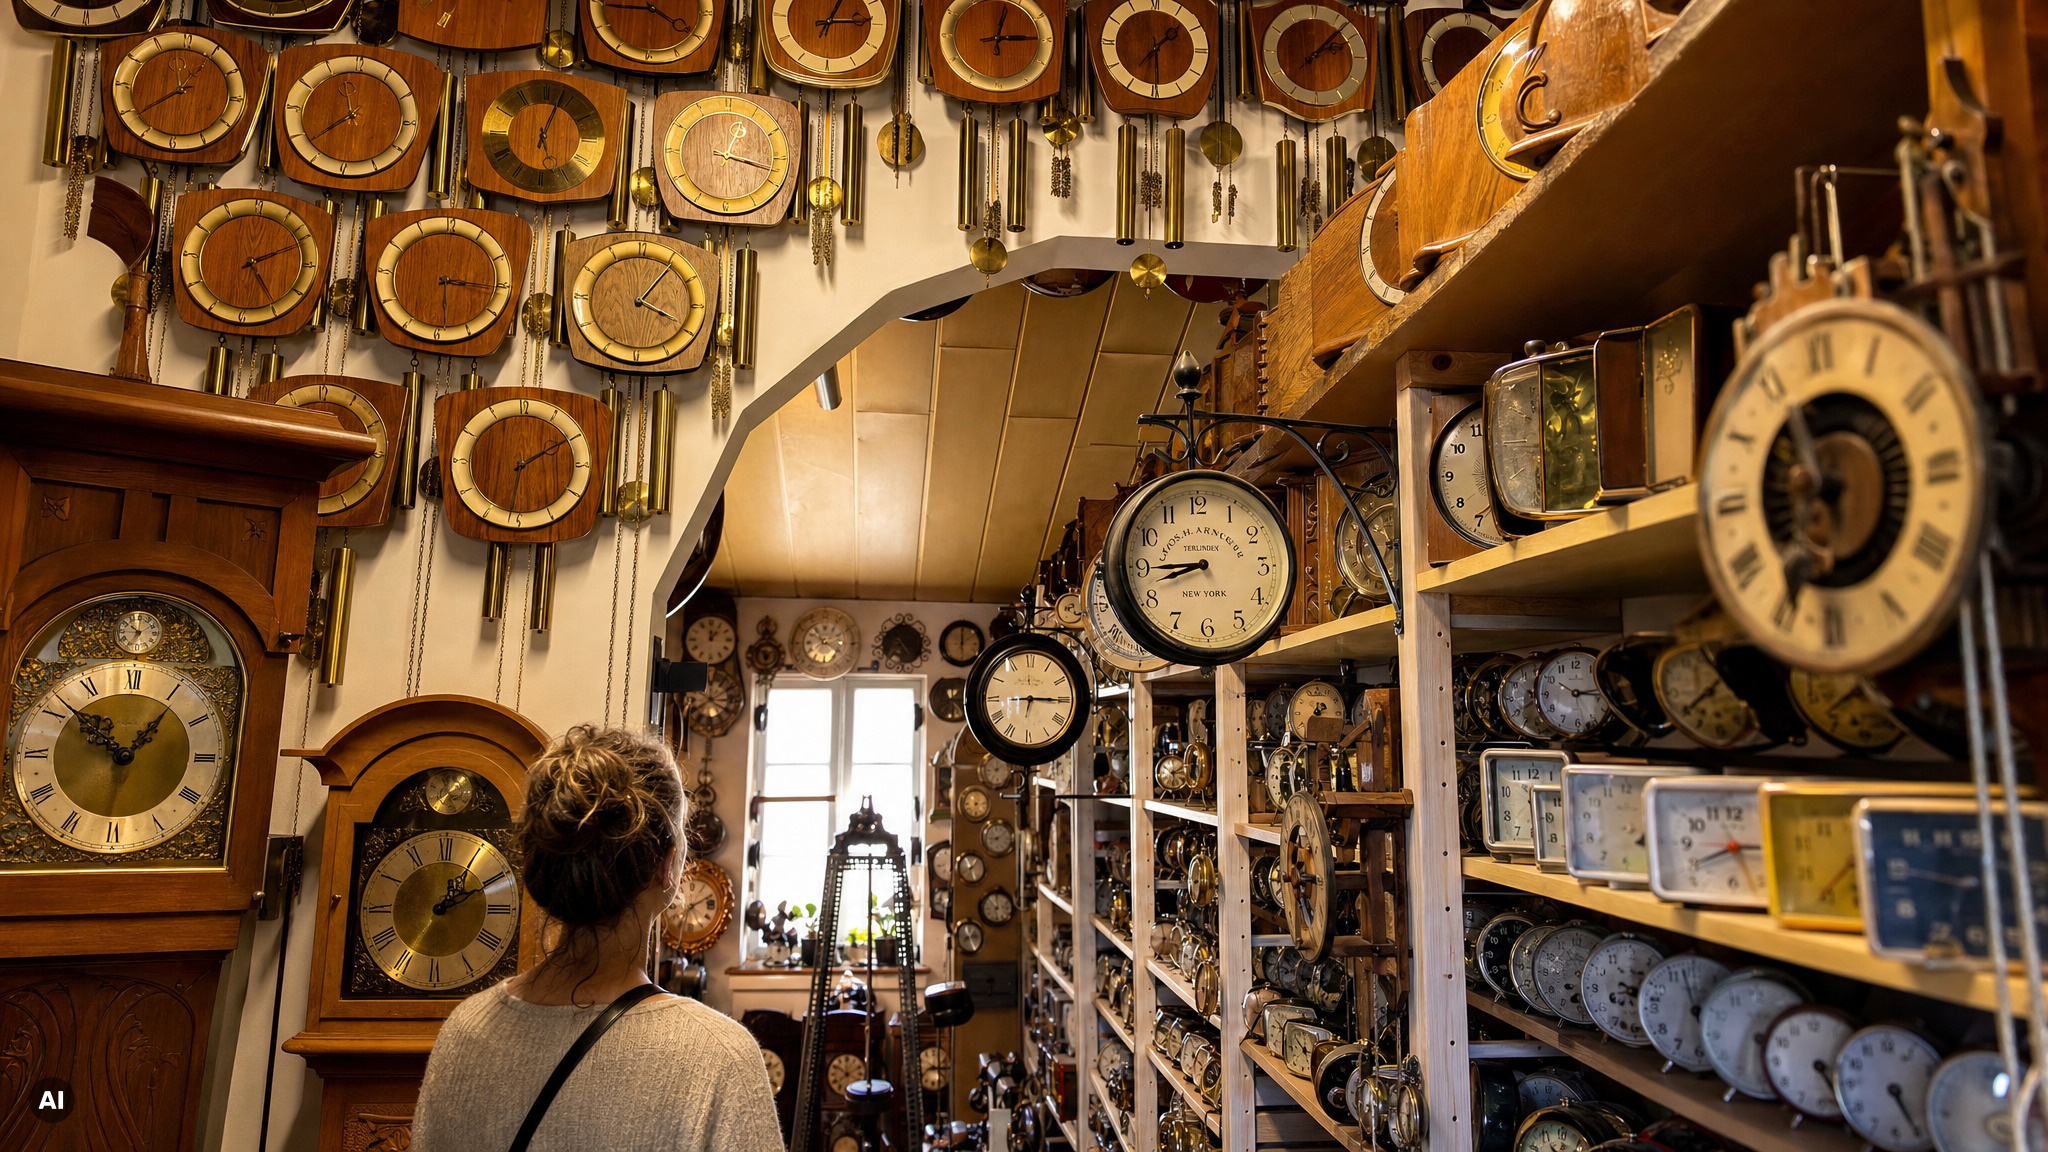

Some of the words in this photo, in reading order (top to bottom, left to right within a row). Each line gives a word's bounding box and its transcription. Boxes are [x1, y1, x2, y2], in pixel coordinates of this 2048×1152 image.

[1807, 331, 1835, 374] XII
[1865, 334, 1882, 376] I
[1759, 366, 1787, 402] XI
[520, 400, 529, 414] 12
[1470, 424, 1482, 437] 11
[1453, 443, 1466, 455] 10
[1445, 471, 1454, 482] 9
[1190, 496, 1207, 515] 12
[1456, 497, 1465, 508] 8
[1163, 505, 1175, 524] 11
[1227, 505, 1232, 523] 1
[1474, 514, 1484, 527] 7
[1142, 528, 1158, 547] 10
[1246, 526, 1258, 544] 2
[1136, 558, 1150, 578] 9
[1257, 556, 1270, 576] 3
[1146, 589, 1158, 608] 8
[1204, 590, 1227, 598] YORK
[1250, 587, 1264, 605] 4
[1169, 611, 1181, 629] 7
[1233, 610, 1245, 629] 5
[1201, 618, 1214, 637] 6
[1044, 661, 1051, 672] I
[1558, 665, 1565, 673] 11
[1571, 661, 1580, 669] 12
[1590, 665, 1592, 673] 1
[80, 676, 98, 697] XI
[124, 670, 142, 690] XII
[1054, 676, 1066, 686] II
[1548, 676, 1555, 684] 10
[165, 684, 181, 700] I
[42, 705, 66, 723] X
[1549, 704, 1555, 712] 8
[188, 713, 209, 728] II
[1052, 712, 1066, 726] IIII
[1560, 715, 1566, 723] 7
[1575, 719, 1581, 728] 6
[24, 746, 49, 759] IX
[193, 752, 216, 763] III
[1512, 770, 1520, 780] 11
[1528, 769, 1539, 779] 12
[1549, 771, 1553, 781] 1
[30, 782, 56, 805] VIII
[178, 785, 202, 805] IIII
[1501, 786, 1511, 797] 10
[1603, 787, 1612, 798] 11
[1621, 784, 1632, 794] 12
[1504, 810, 1511, 821] 8
[1706, 806, 1719, 820] 11
[1726, 806, 1743, 821] 12
[60, 810, 82, 835] VII
[152, 813, 165, 833] V
[1689, 817, 1705, 833] 10
[106, 821, 120, 843] VI
[1514, 826, 1521, 836] 7
[1550, 833, 1557, 843] 8
[437, 838, 453, 862] XII
[1681, 835, 1692, 851] 9
[406, 846, 423, 870] XI
[483, 871, 506, 887] II
[487, 904, 511, 915] III
[372, 926, 397, 952] VIII
[476, 928, 502, 952] IIII
[393, 949, 413, 975] VII
[1609, 954, 1617, 964] 11
[429, 958, 440, 983] VI
[1668, 971, 1678, 982] 11
[1658, 1023, 1668, 1035] 8
[1674, 1038, 1683, 1050] 7
